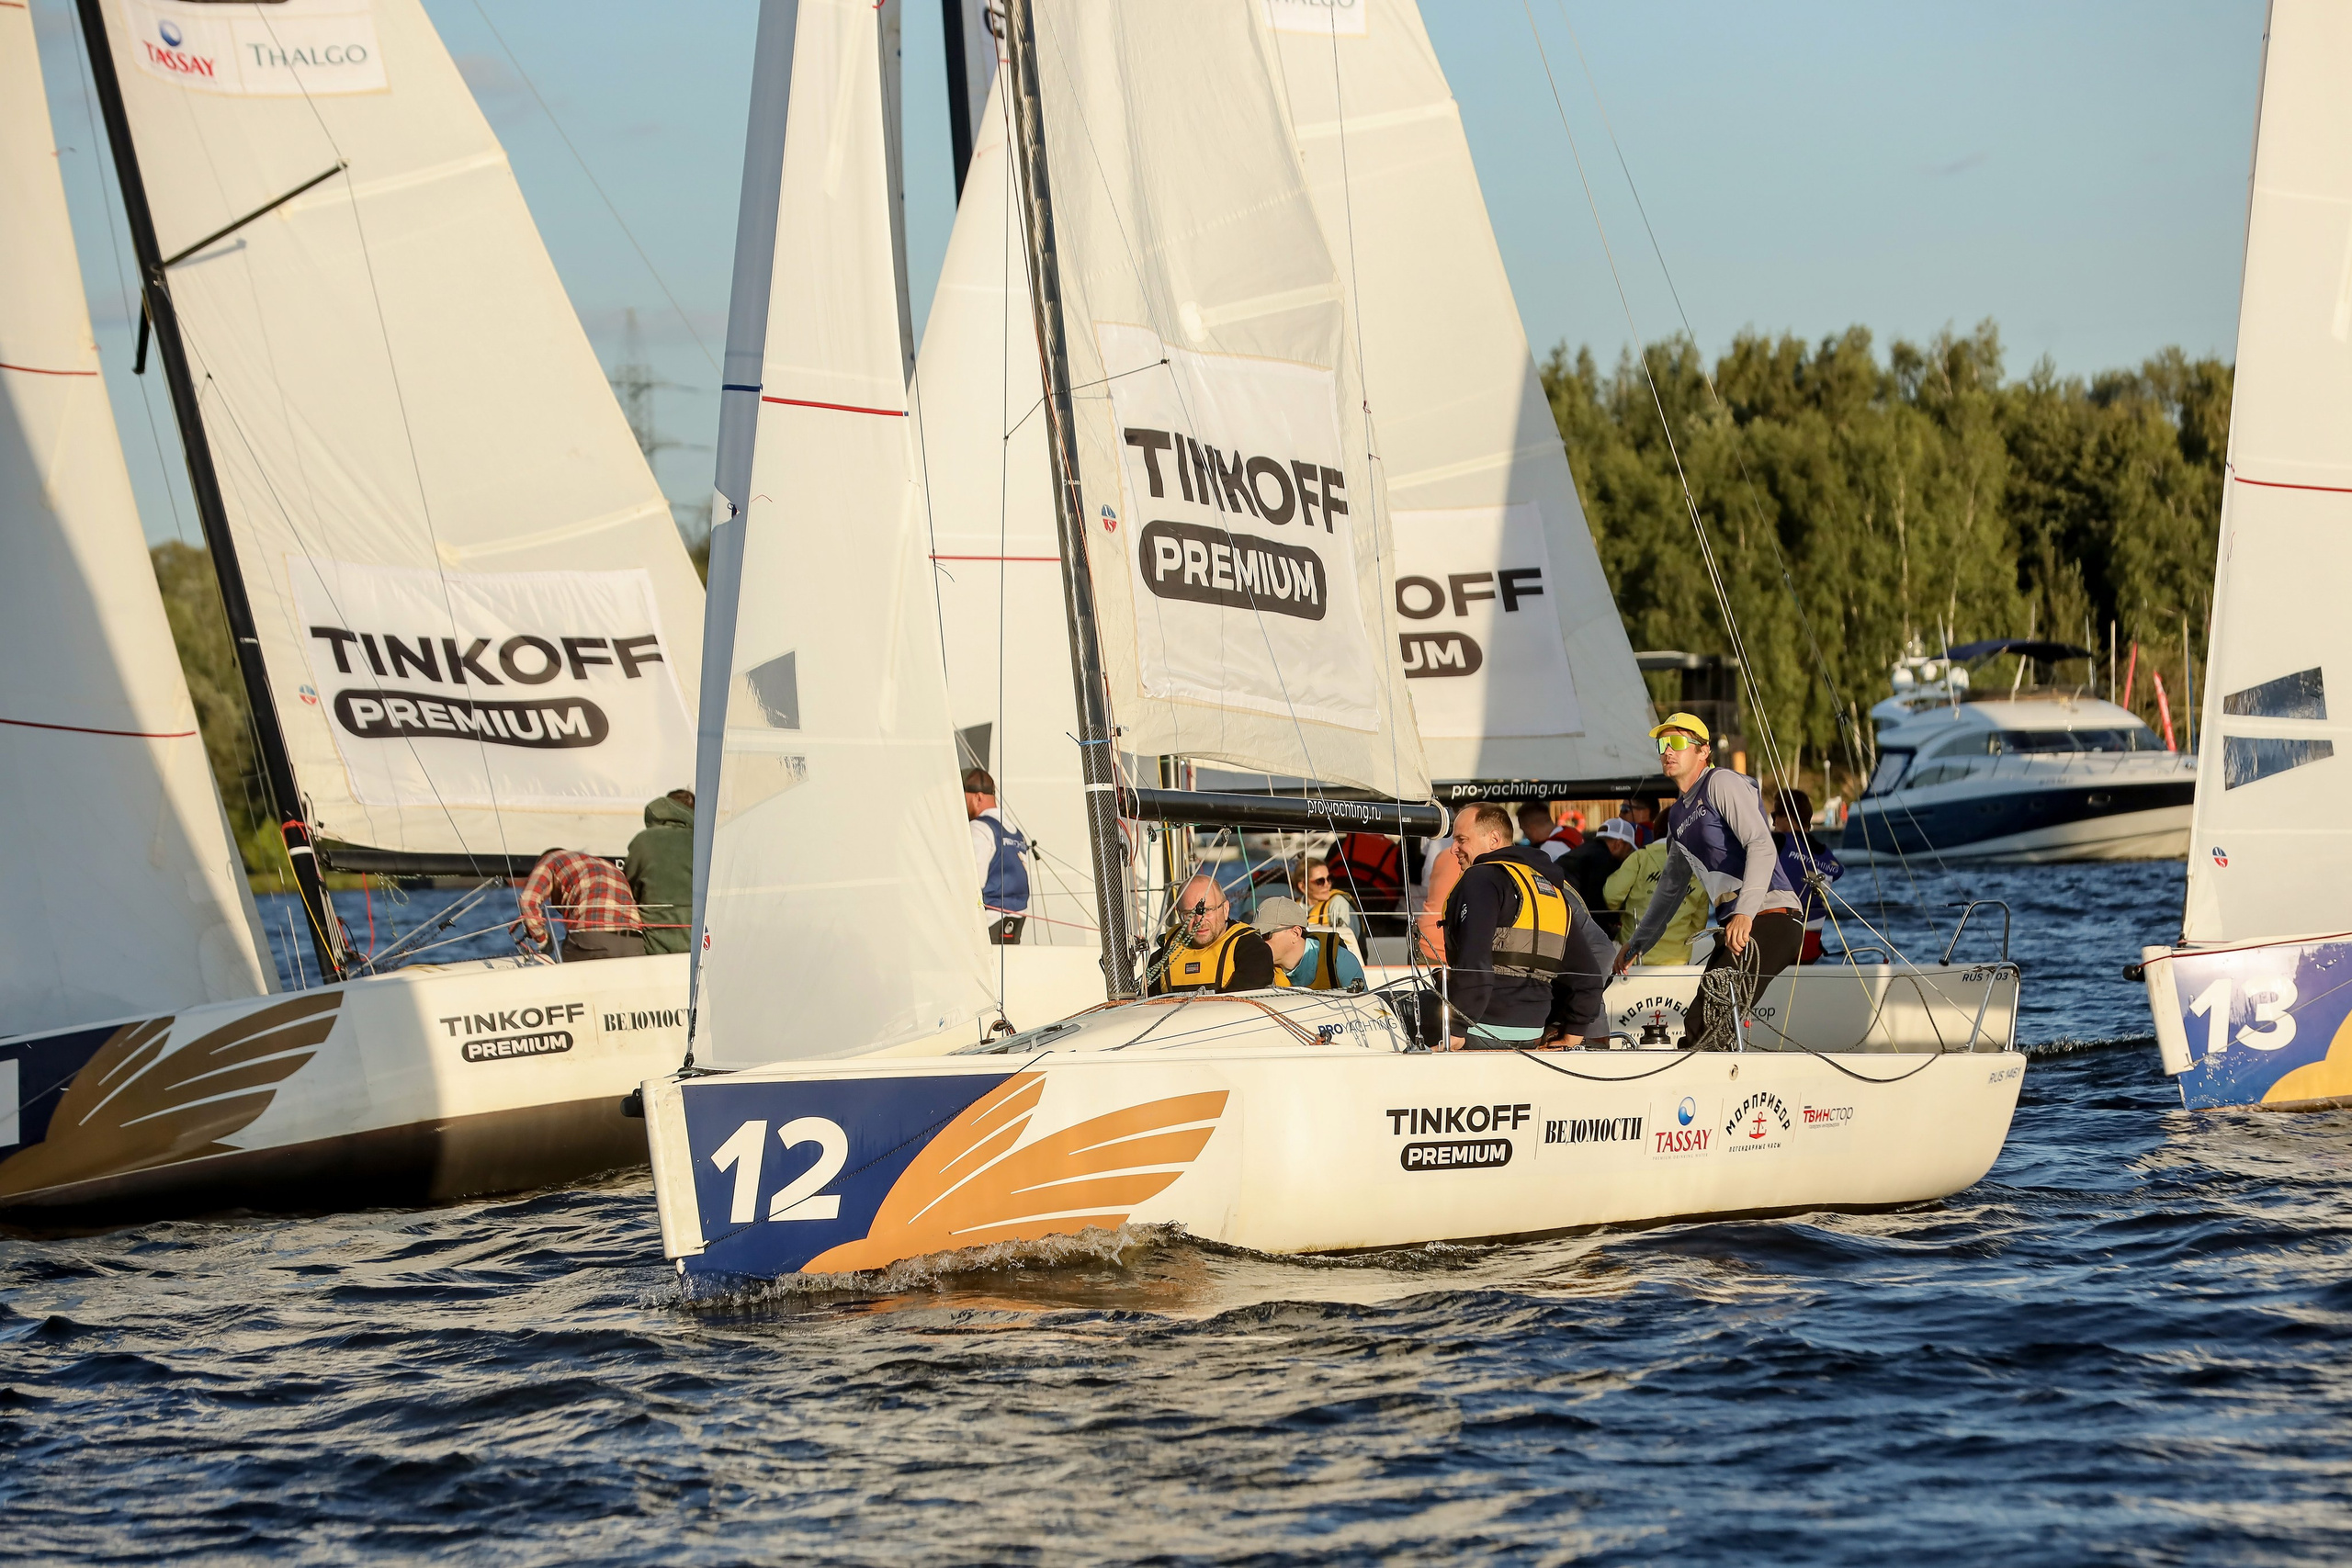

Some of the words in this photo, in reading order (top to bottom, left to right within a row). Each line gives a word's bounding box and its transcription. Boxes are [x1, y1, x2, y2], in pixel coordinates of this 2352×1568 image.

[142, 41, 215, 78] TASSAY
[246, 43, 368, 68] THALGO
[1124, 427, 1349, 535] TINKOFF
[1154, 535, 1318, 606] PREMIUM
[310, 626, 664, 686] TINKOFF
[355, 695, 593, 743] PREMIUM
[1451, 782, 1567, 800] pro-yachting.ru
[1306, 799, 1382, 824] proyachting.ru
[1676, 804, 1707, 839] PROYACHTING
[1962, 973, 1983, 982] RUS
[1985, 972, 2008, 981] 103
[439, 1002, 585, 1039] TINKOFF
[603, 1008, 691, 1032] ВЕДОМОСТ
[1619, 997, 1690, 1026] МОРПРИБО
[2188, 978, 2298, 1054] 13
[469, 1034, 567, 1058] PREMIUM
[1988, 1070, 2005, 1084] RUS
[1386, 1103, 1532, 1135] TINKOFF
[1725, 1092, 1791, 1135] МОРПРИБОР
[1544, 1117, 1643, 1145] ВЕДОМОСТИ
[1655, 1129, 1713, 1154] TASSAY
[710, 1116, 849, 1224] 12
[1408, 1144, 1507, 1166] PREMIUM
